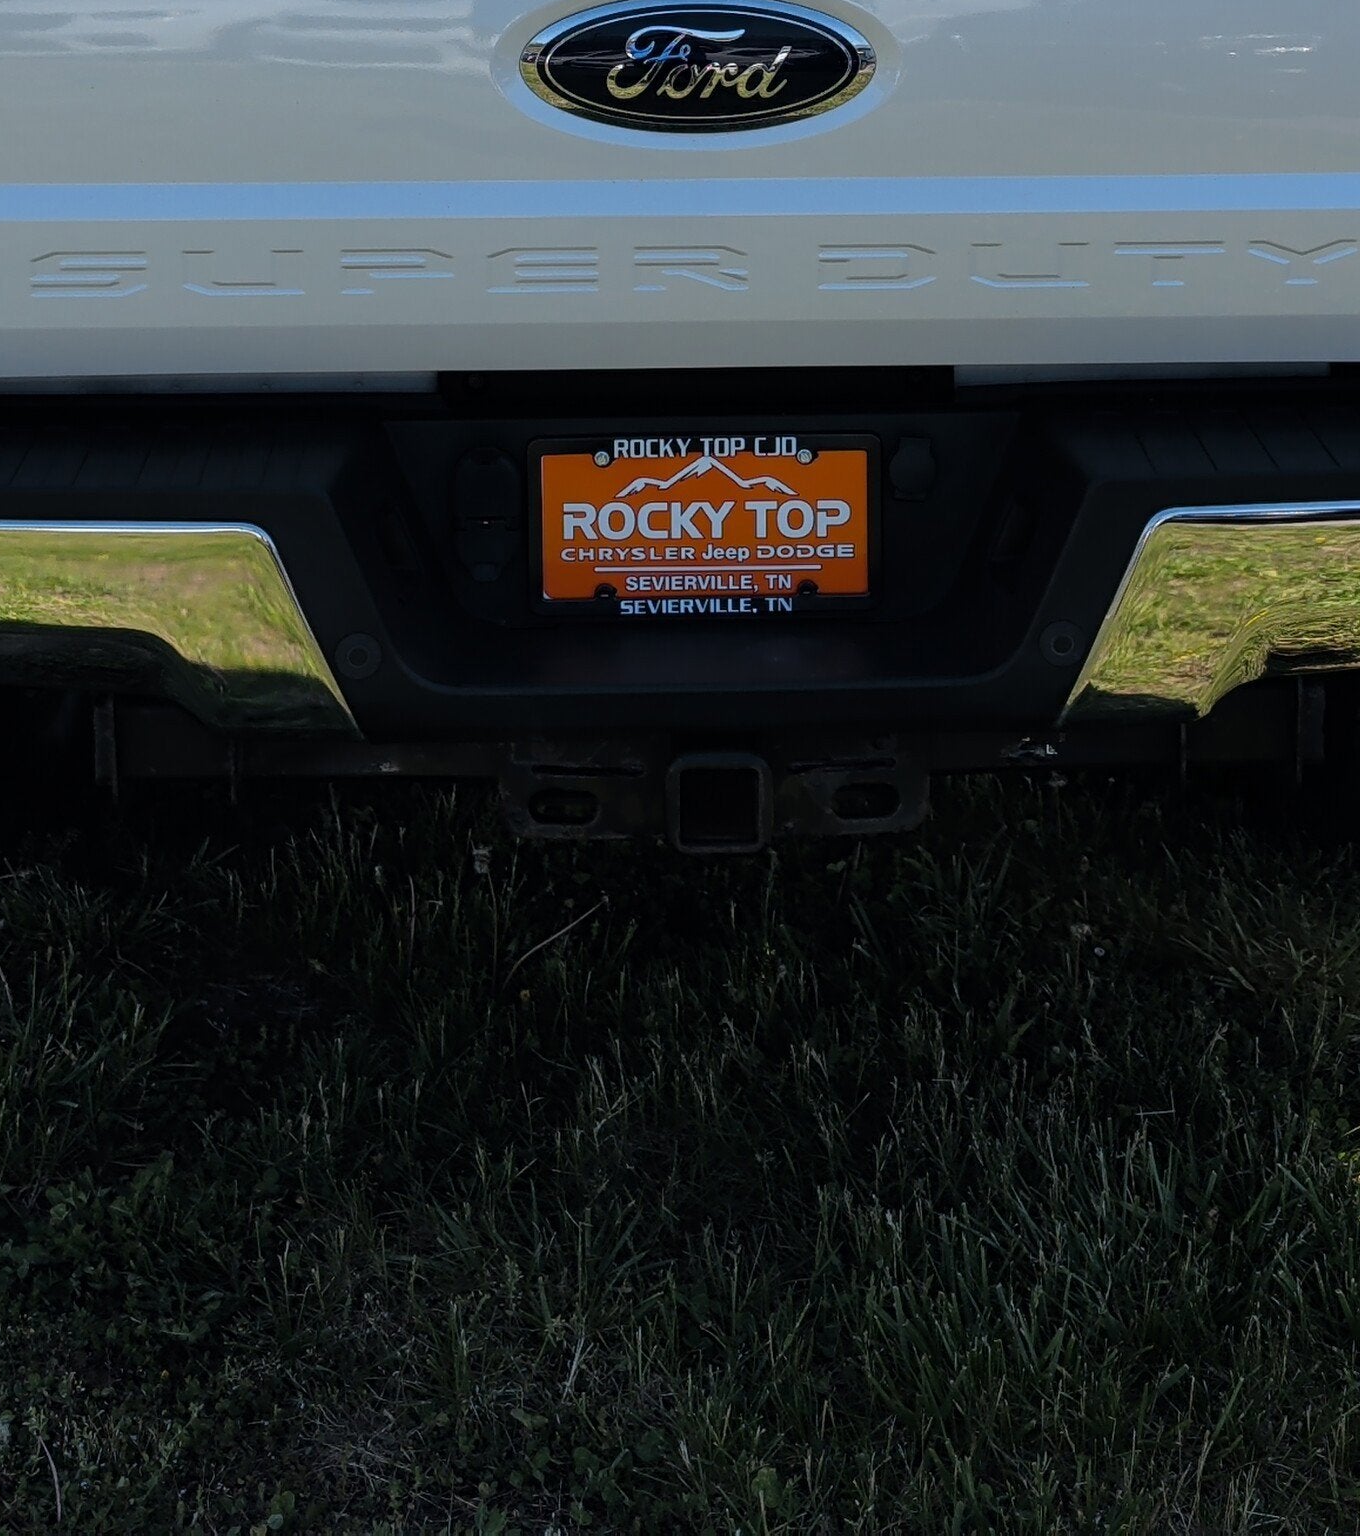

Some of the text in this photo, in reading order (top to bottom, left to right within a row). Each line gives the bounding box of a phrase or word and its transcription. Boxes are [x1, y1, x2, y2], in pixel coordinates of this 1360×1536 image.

[606, 25, 793, 99] Ford
[30, 239, 1358, 297] SUPER DUTY
[613, 436, 798, 459] ROCKY TOP CJD
[562, 499, 851, 540] ROCKY TOP
[560, 543, 855, 562] CHRYSLER Jeep DODGE
[625, 574, 792, 593] SEVIERVILLE, TN
[765, 597, 793, 612] TN
